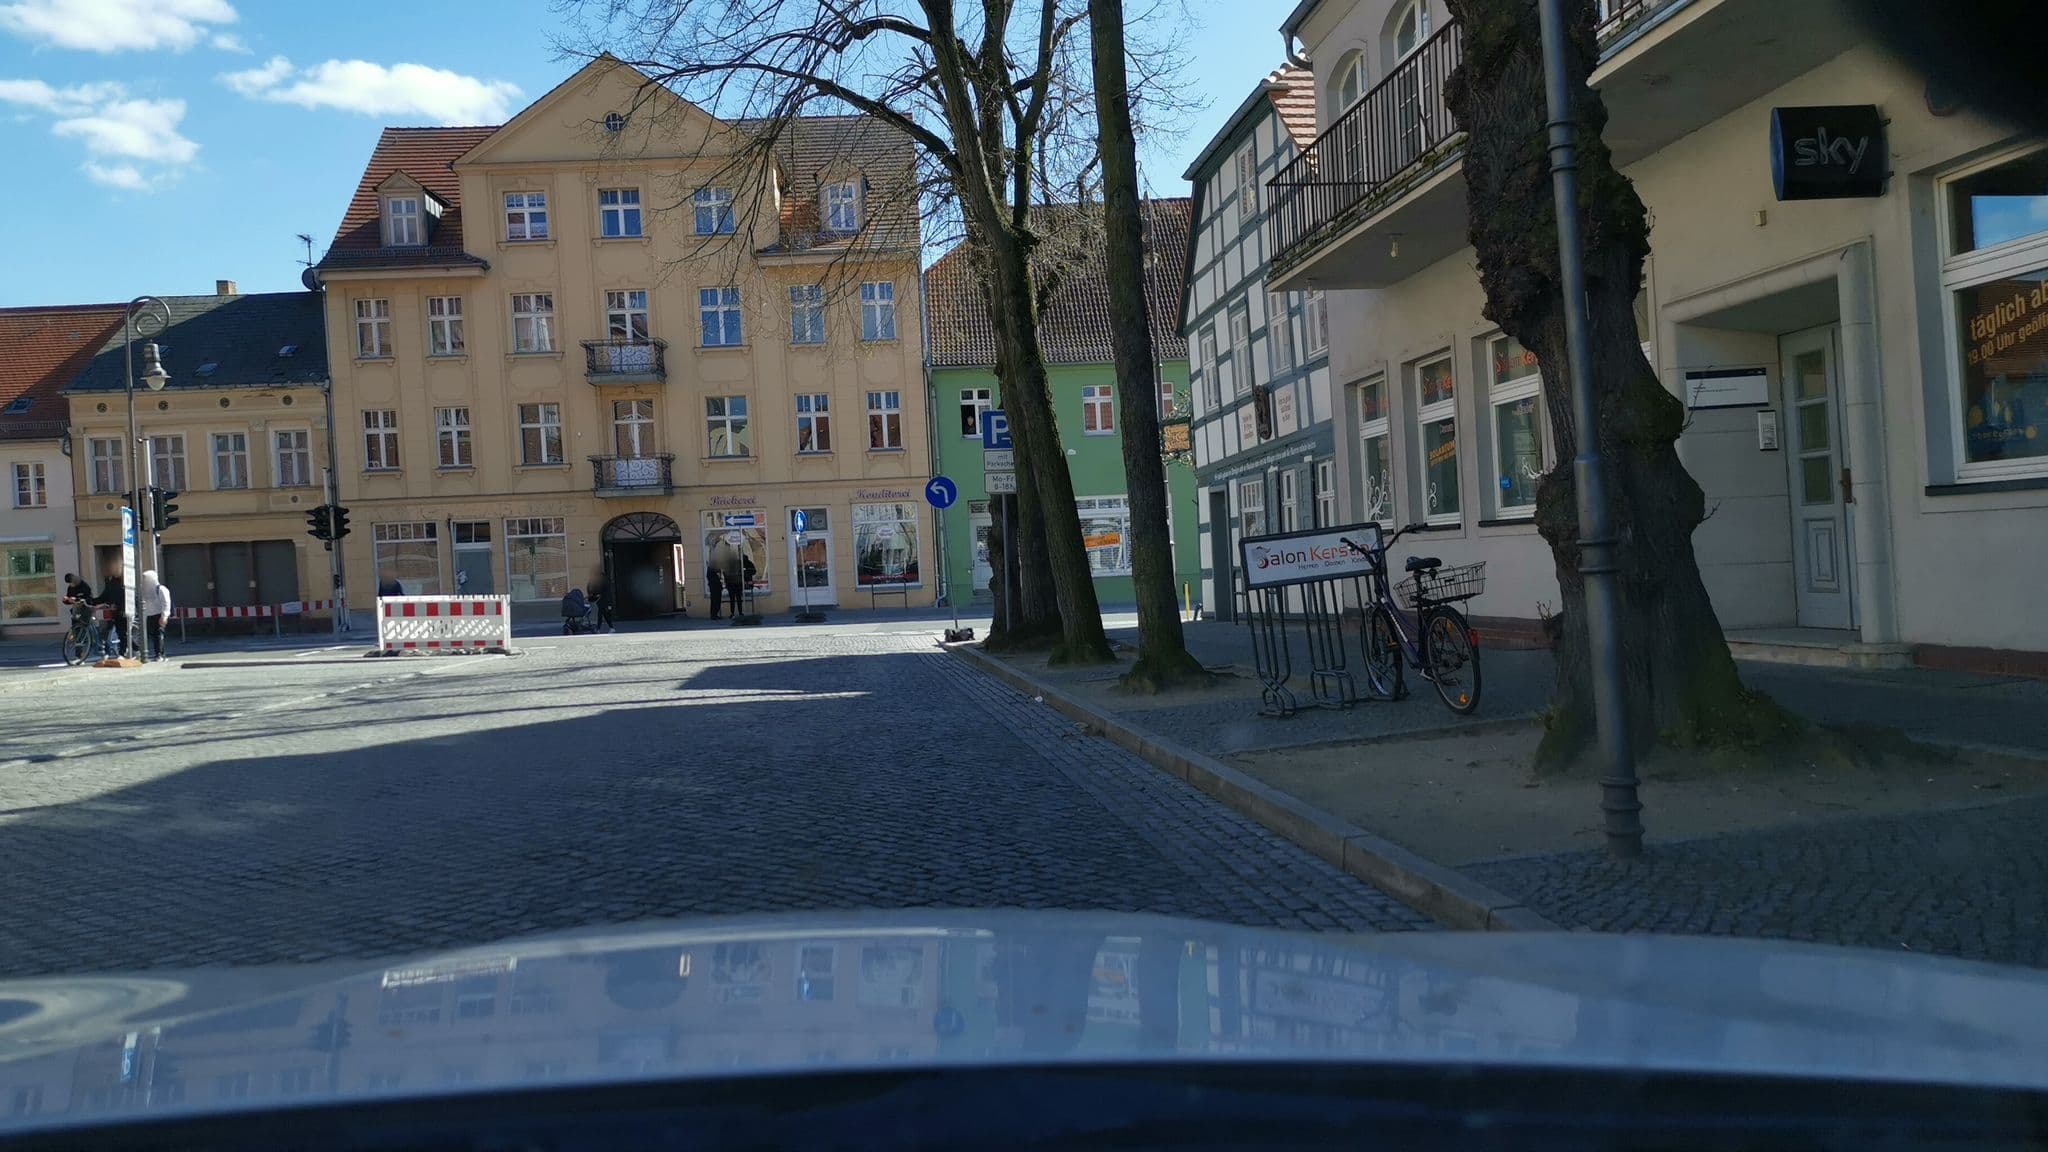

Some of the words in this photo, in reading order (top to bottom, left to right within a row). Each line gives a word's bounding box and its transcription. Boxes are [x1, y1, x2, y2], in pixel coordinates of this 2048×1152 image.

[1793, 127, 1868, 174] sky
[1970, 293, 2026, 341] täglich
[1996, 332, 2016, 351] Uhr
[991, 415, 1009, 445] P
